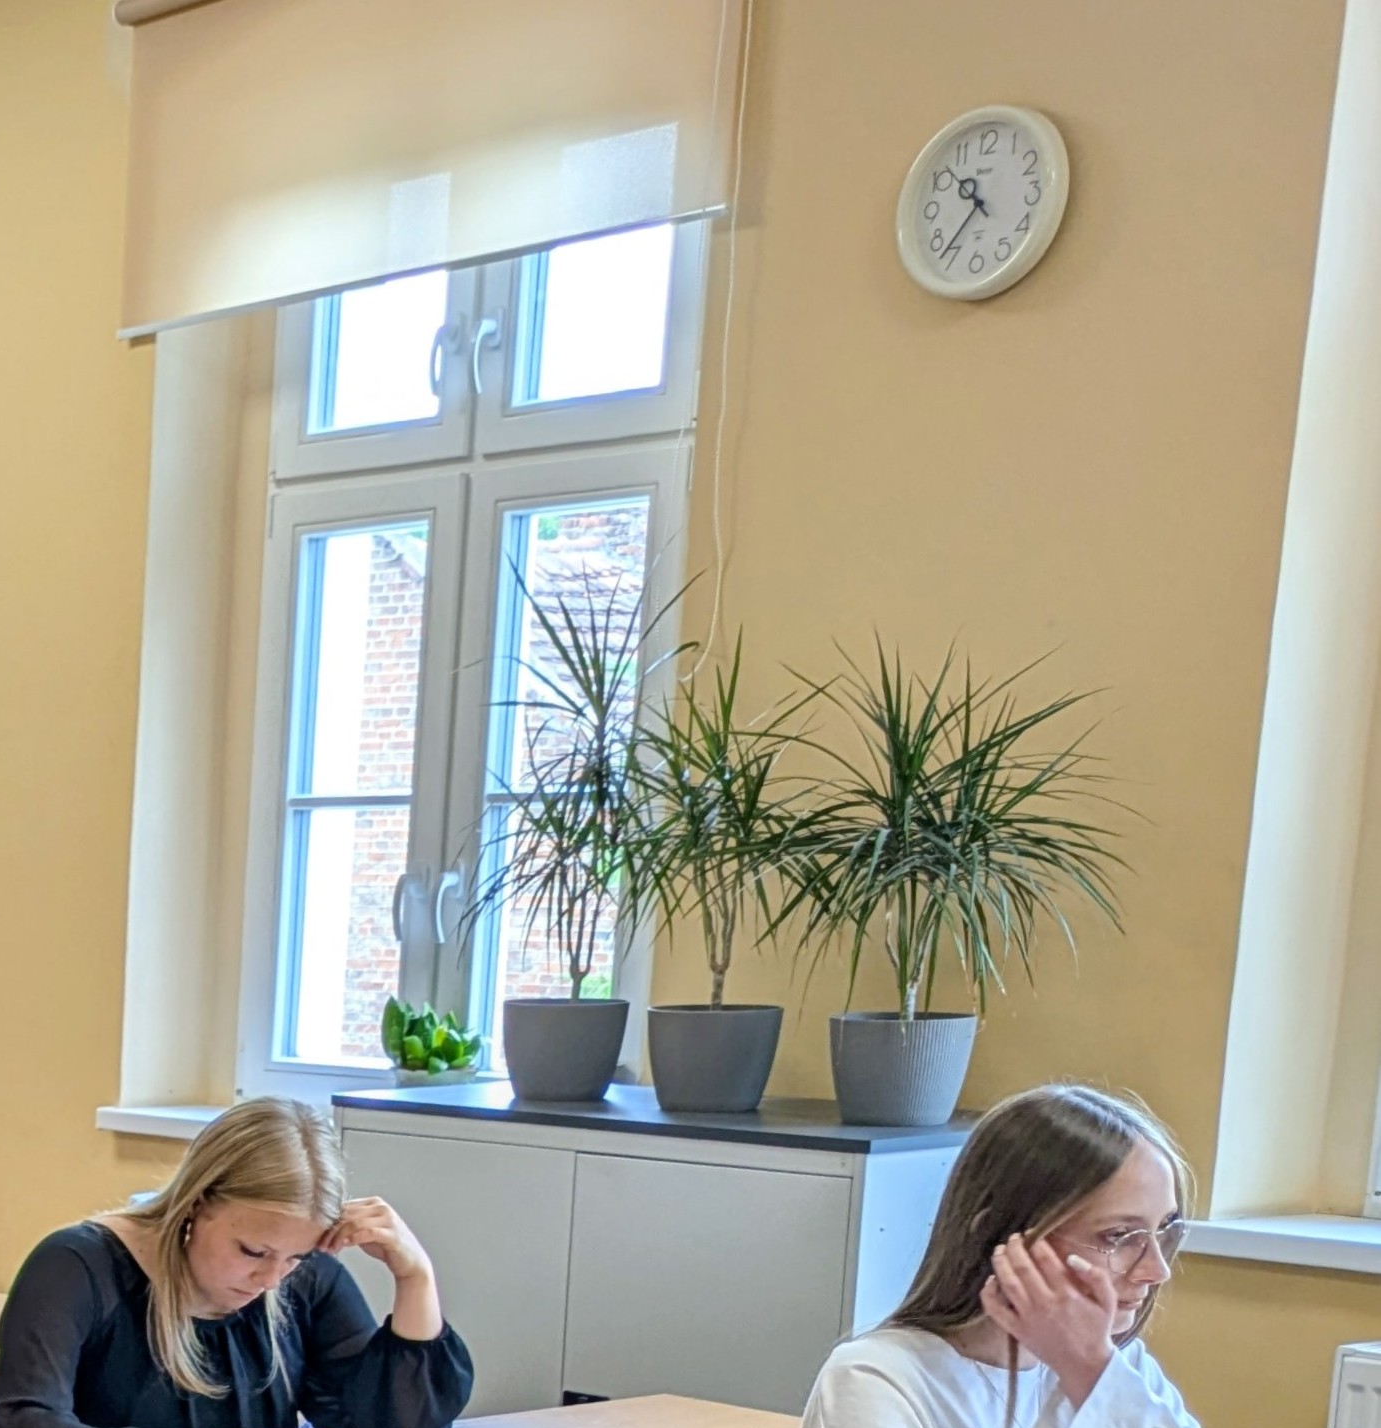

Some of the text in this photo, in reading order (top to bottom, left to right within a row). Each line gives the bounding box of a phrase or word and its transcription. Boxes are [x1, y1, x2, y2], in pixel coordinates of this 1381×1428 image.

[955, 141, 970, 167] 11
[979, 129, 999, 156] 12
[1011, 131, 1018, 156] 1
[1022, 149, 1038, 176] 2
[932, 169, 953, 193] 10
[1024, 180, 1042, 206] 3
[923, 200, 940, 224] 9
[1014, 211, 1032, 234] 4
[930, 228, 945, 253] 8
[994, 237, 1012, 262] 5
[945, 245, 962, 272] 7
[968, 251, 985, 274] 6
